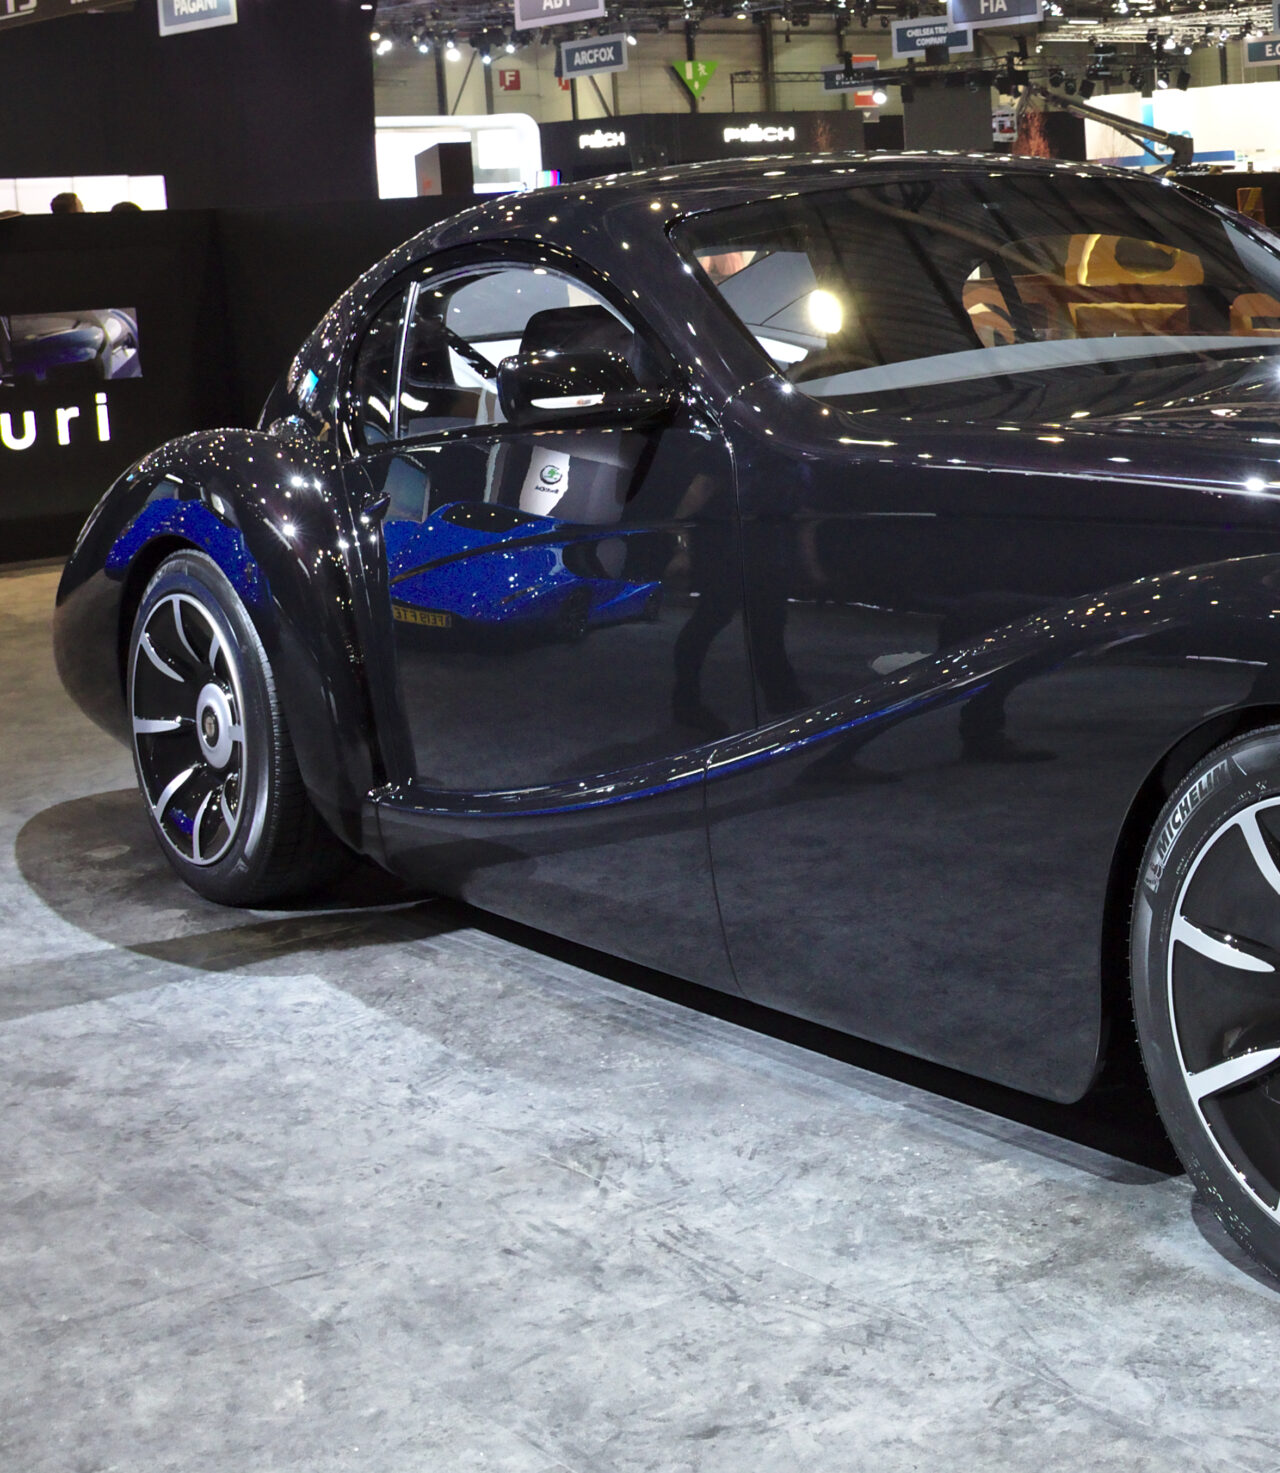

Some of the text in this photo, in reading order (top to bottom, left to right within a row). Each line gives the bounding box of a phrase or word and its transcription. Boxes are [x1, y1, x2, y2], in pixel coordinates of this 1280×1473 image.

[174, 0, 219, 16] PAGANI
[979, 0, 1008, 15] FIA
[573, 46, 615, 66] ARCFOX
[505, 71, 516, 86] F
[1156, 759, 1232, 860] MICHELIN
